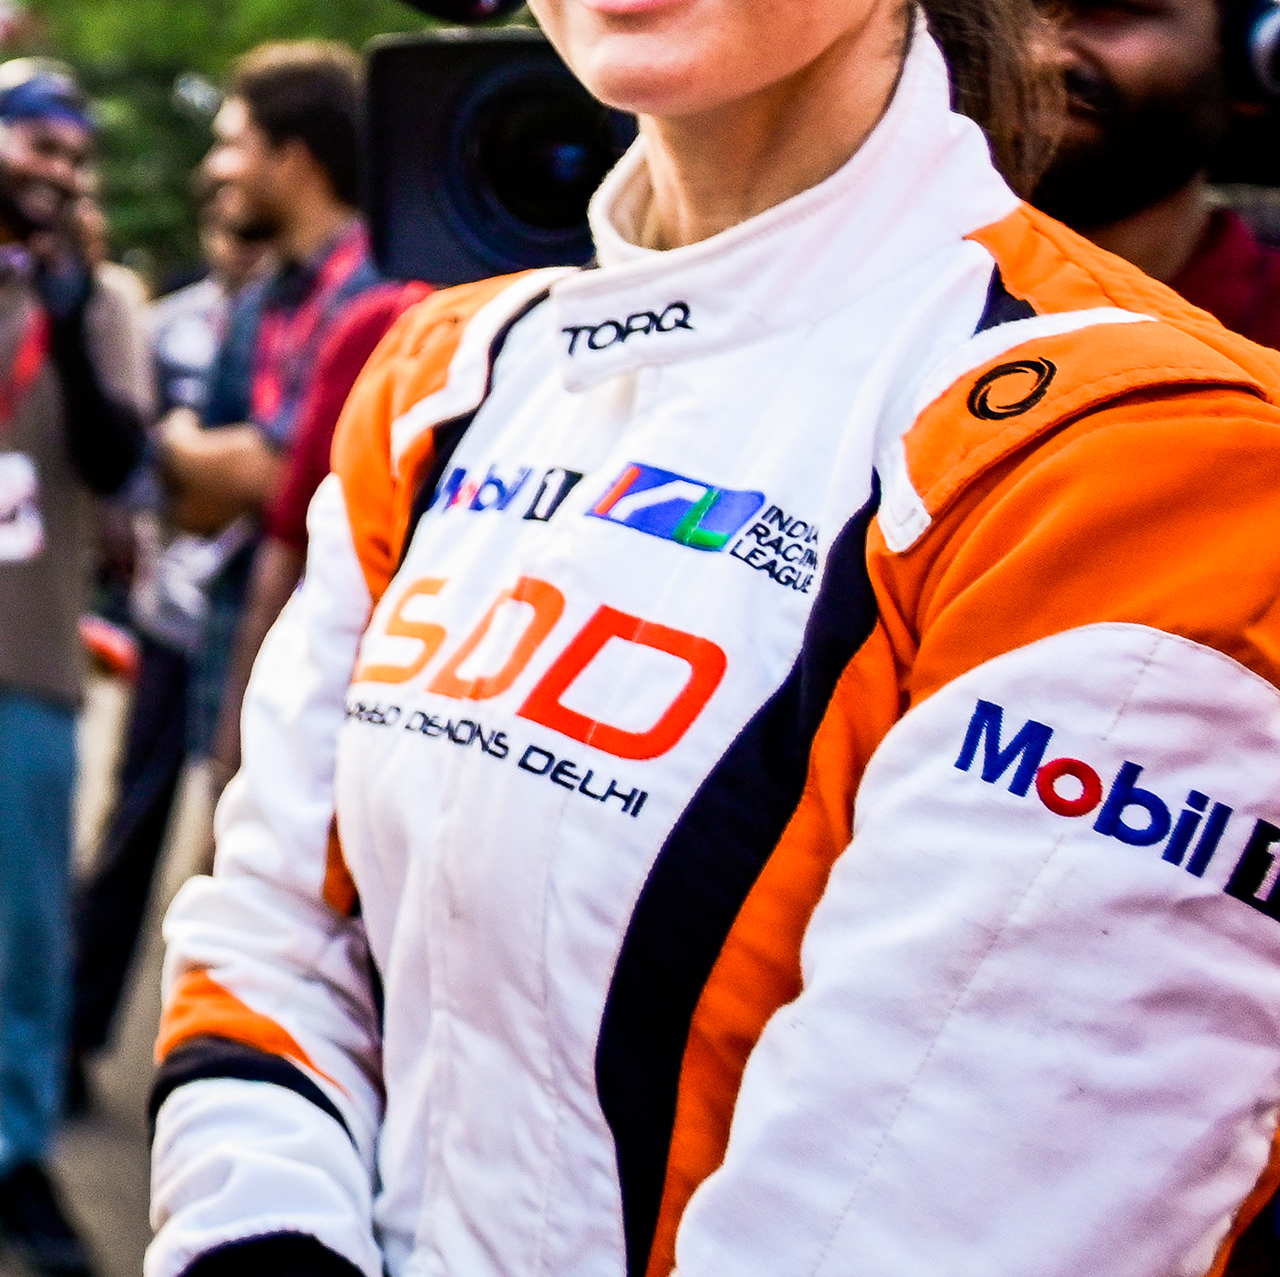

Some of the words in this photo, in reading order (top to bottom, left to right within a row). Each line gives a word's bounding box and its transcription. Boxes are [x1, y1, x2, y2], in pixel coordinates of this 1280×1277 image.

[562, 300, 695, 356] TORQ
[351, 576, 728, 761] SDD
[517, 744, 649, 818] DELHI
[954, 698, 1234, 878] Mobil
